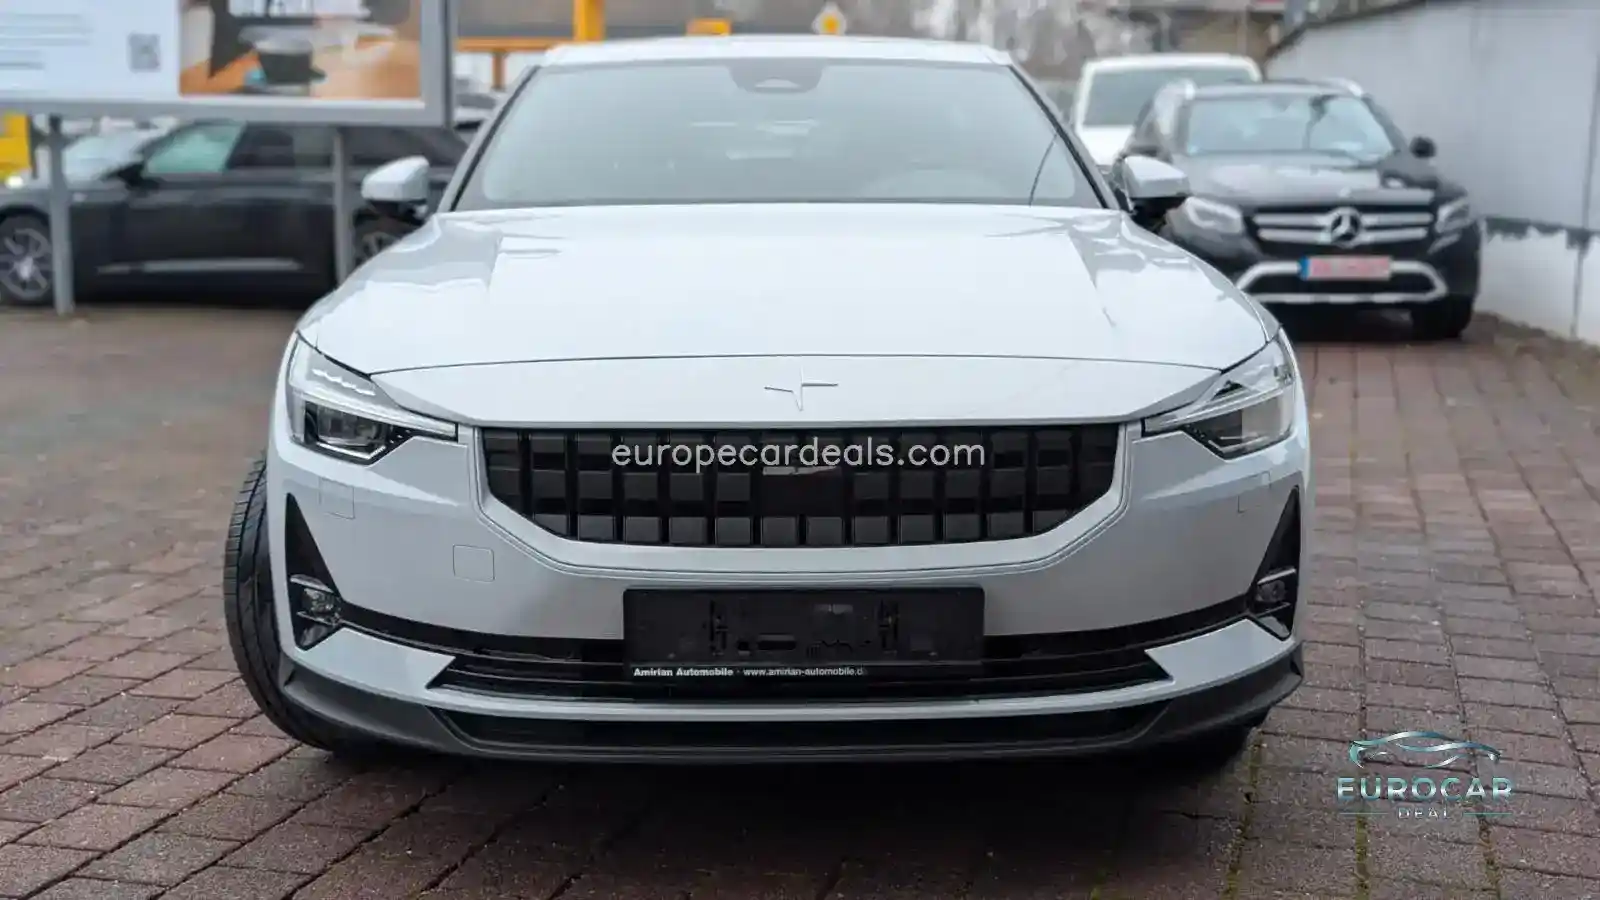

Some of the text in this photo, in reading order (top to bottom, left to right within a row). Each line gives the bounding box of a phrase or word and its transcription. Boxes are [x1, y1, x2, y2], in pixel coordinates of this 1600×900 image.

[633, 667, 868, 677] Amirian Automobile www.amirian-automobile.d
